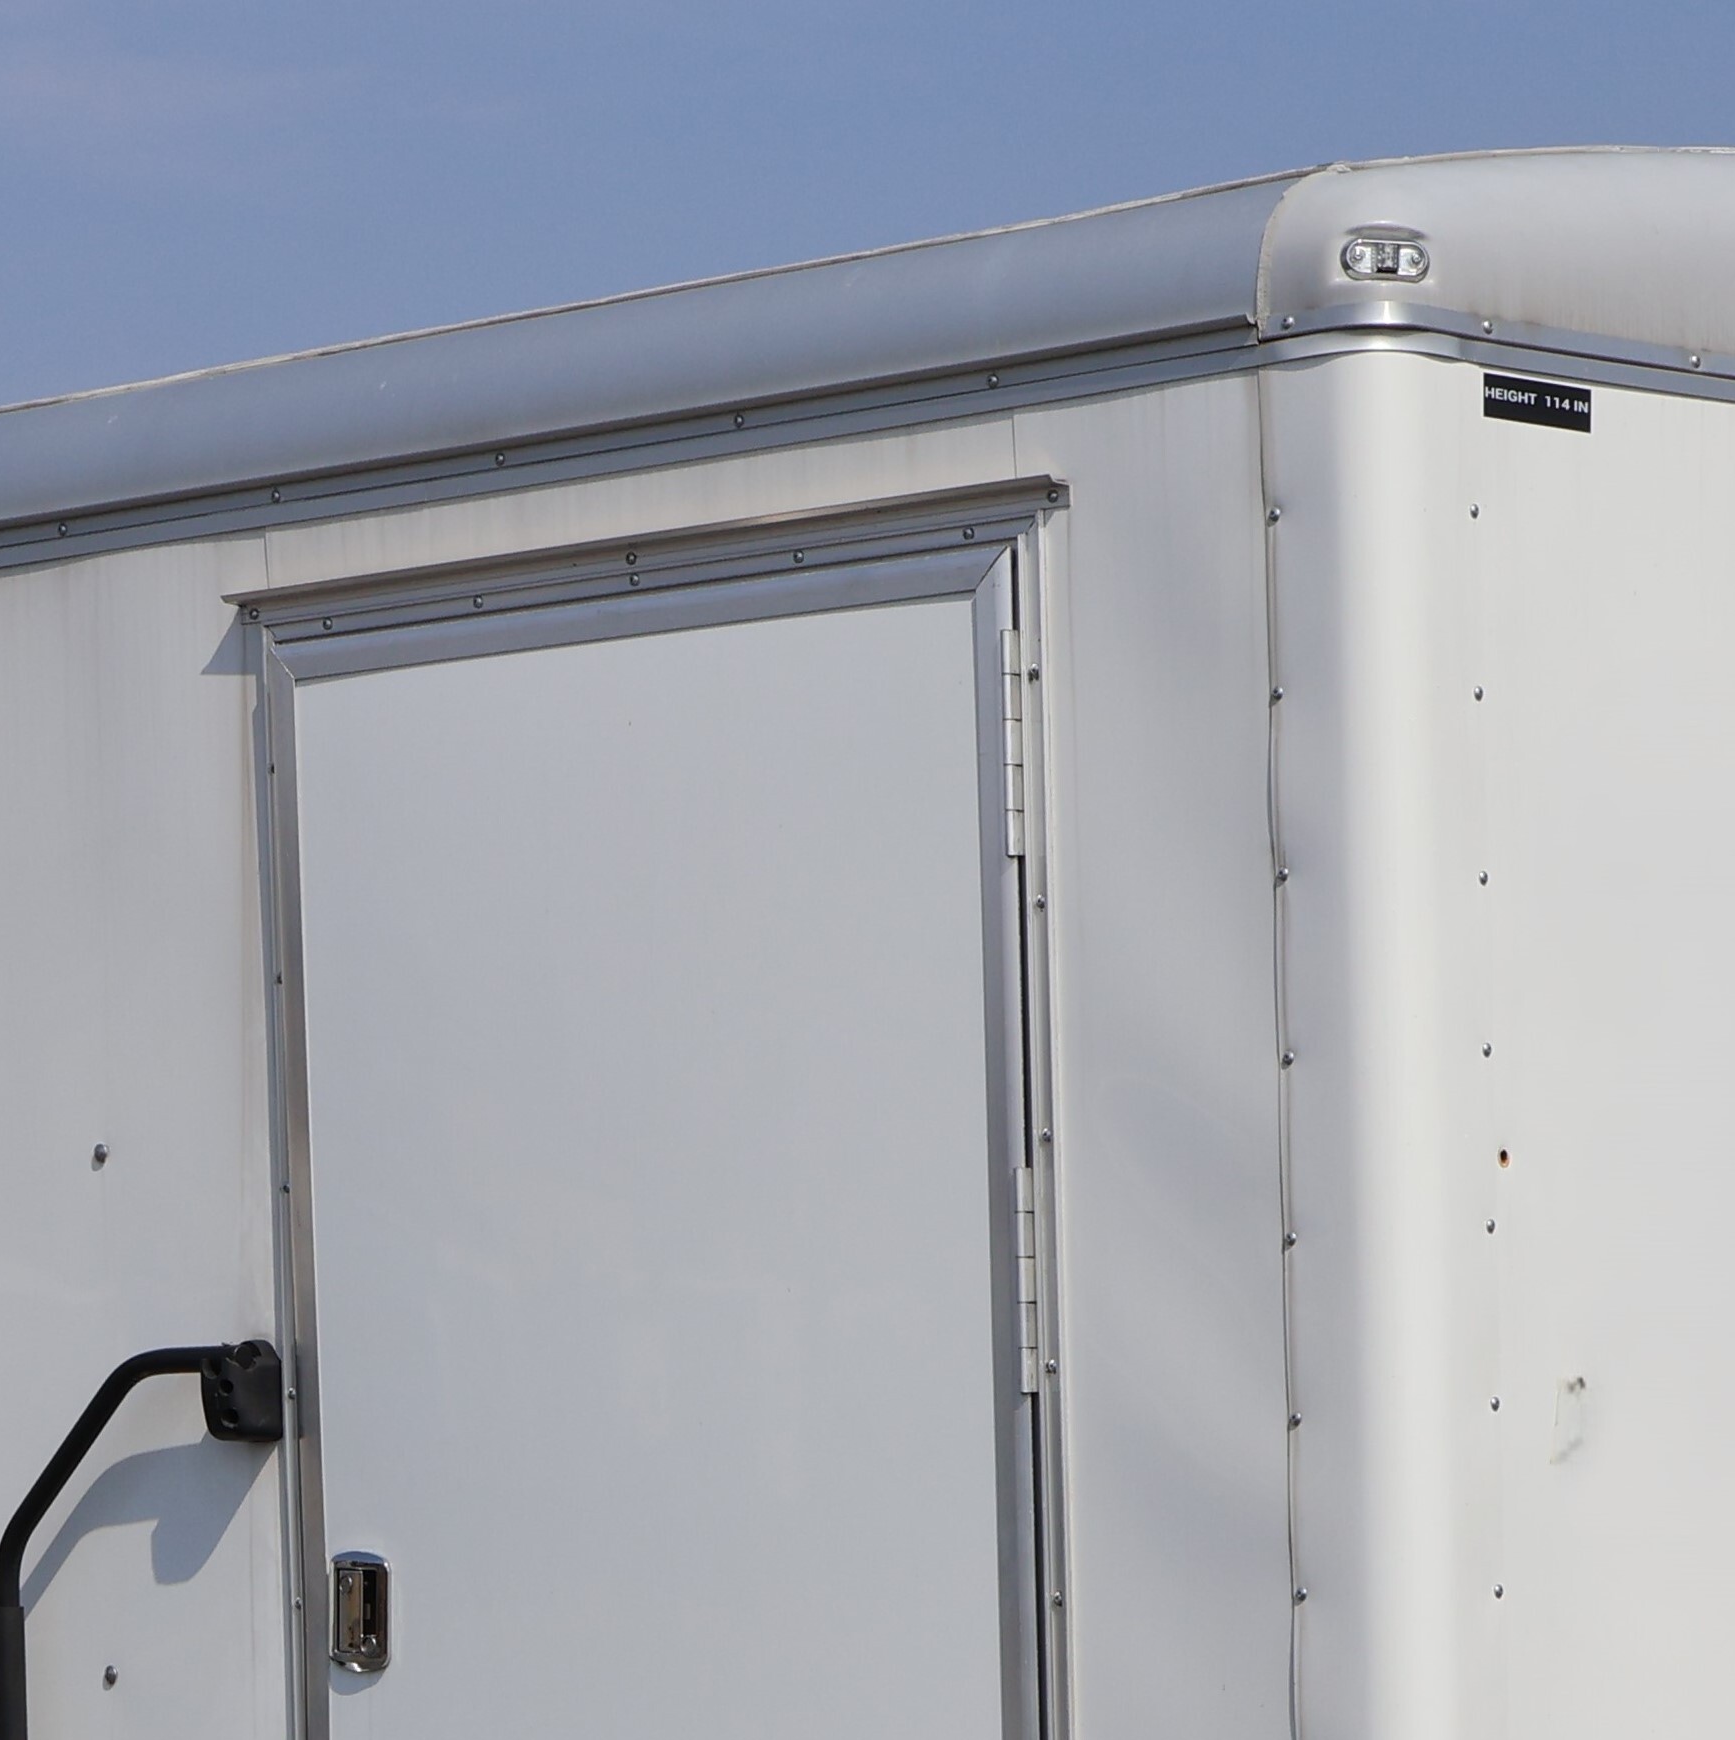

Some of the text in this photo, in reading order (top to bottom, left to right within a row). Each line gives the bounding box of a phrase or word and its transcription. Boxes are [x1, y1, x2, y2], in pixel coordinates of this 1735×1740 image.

[1485, 386, 1590, 414] HEIGHT 114 IN
